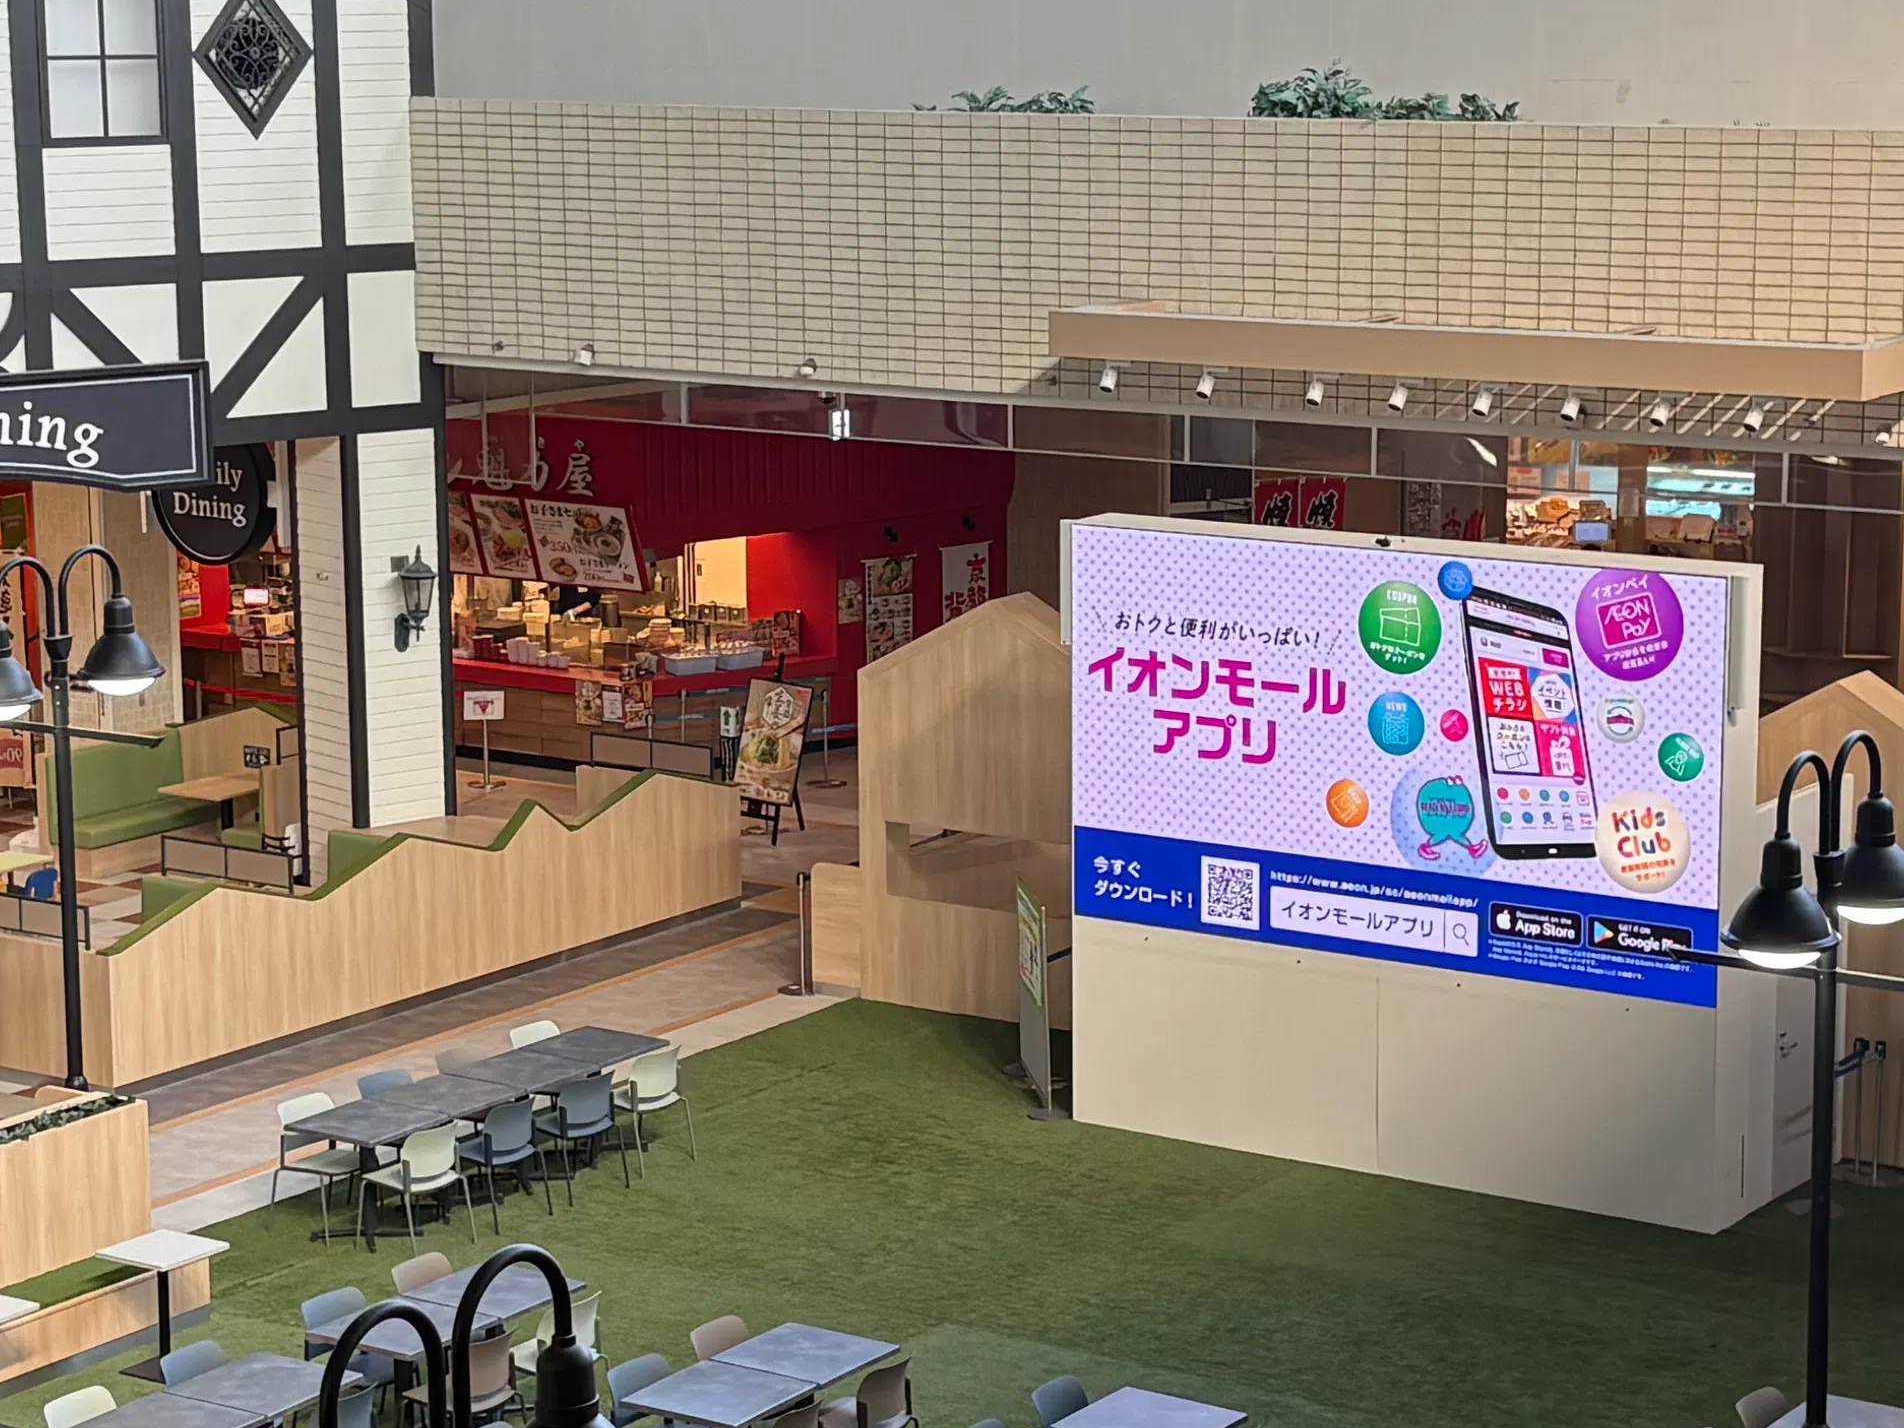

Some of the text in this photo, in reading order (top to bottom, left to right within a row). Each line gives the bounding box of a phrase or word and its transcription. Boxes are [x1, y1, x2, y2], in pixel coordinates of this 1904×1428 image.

[216, 461, 243, 492] ily
[173, 491, 247, 528] Dining
[1591, 574, 1649, 600] イオンペイ
[1621, 617, 1652, 640] Pay
[1088, 646, 1347, 715] イオンモール
[1488, 680, 1525, 697] WEB
[1492, 697, 1527, 712] チラシ
[1153, 708, 1277, 765] アプリ
[1612, 806, 1666, 835] Kids
[1617, 831, 1672, 859] Club
[1093, 856, 1142, 879] 今すぐ
[1281, 900, 1435, 939] イオンモールアプリ
[1515, 919, 1576, 940] App Store
[1618, 933, 1661, 953] Google
